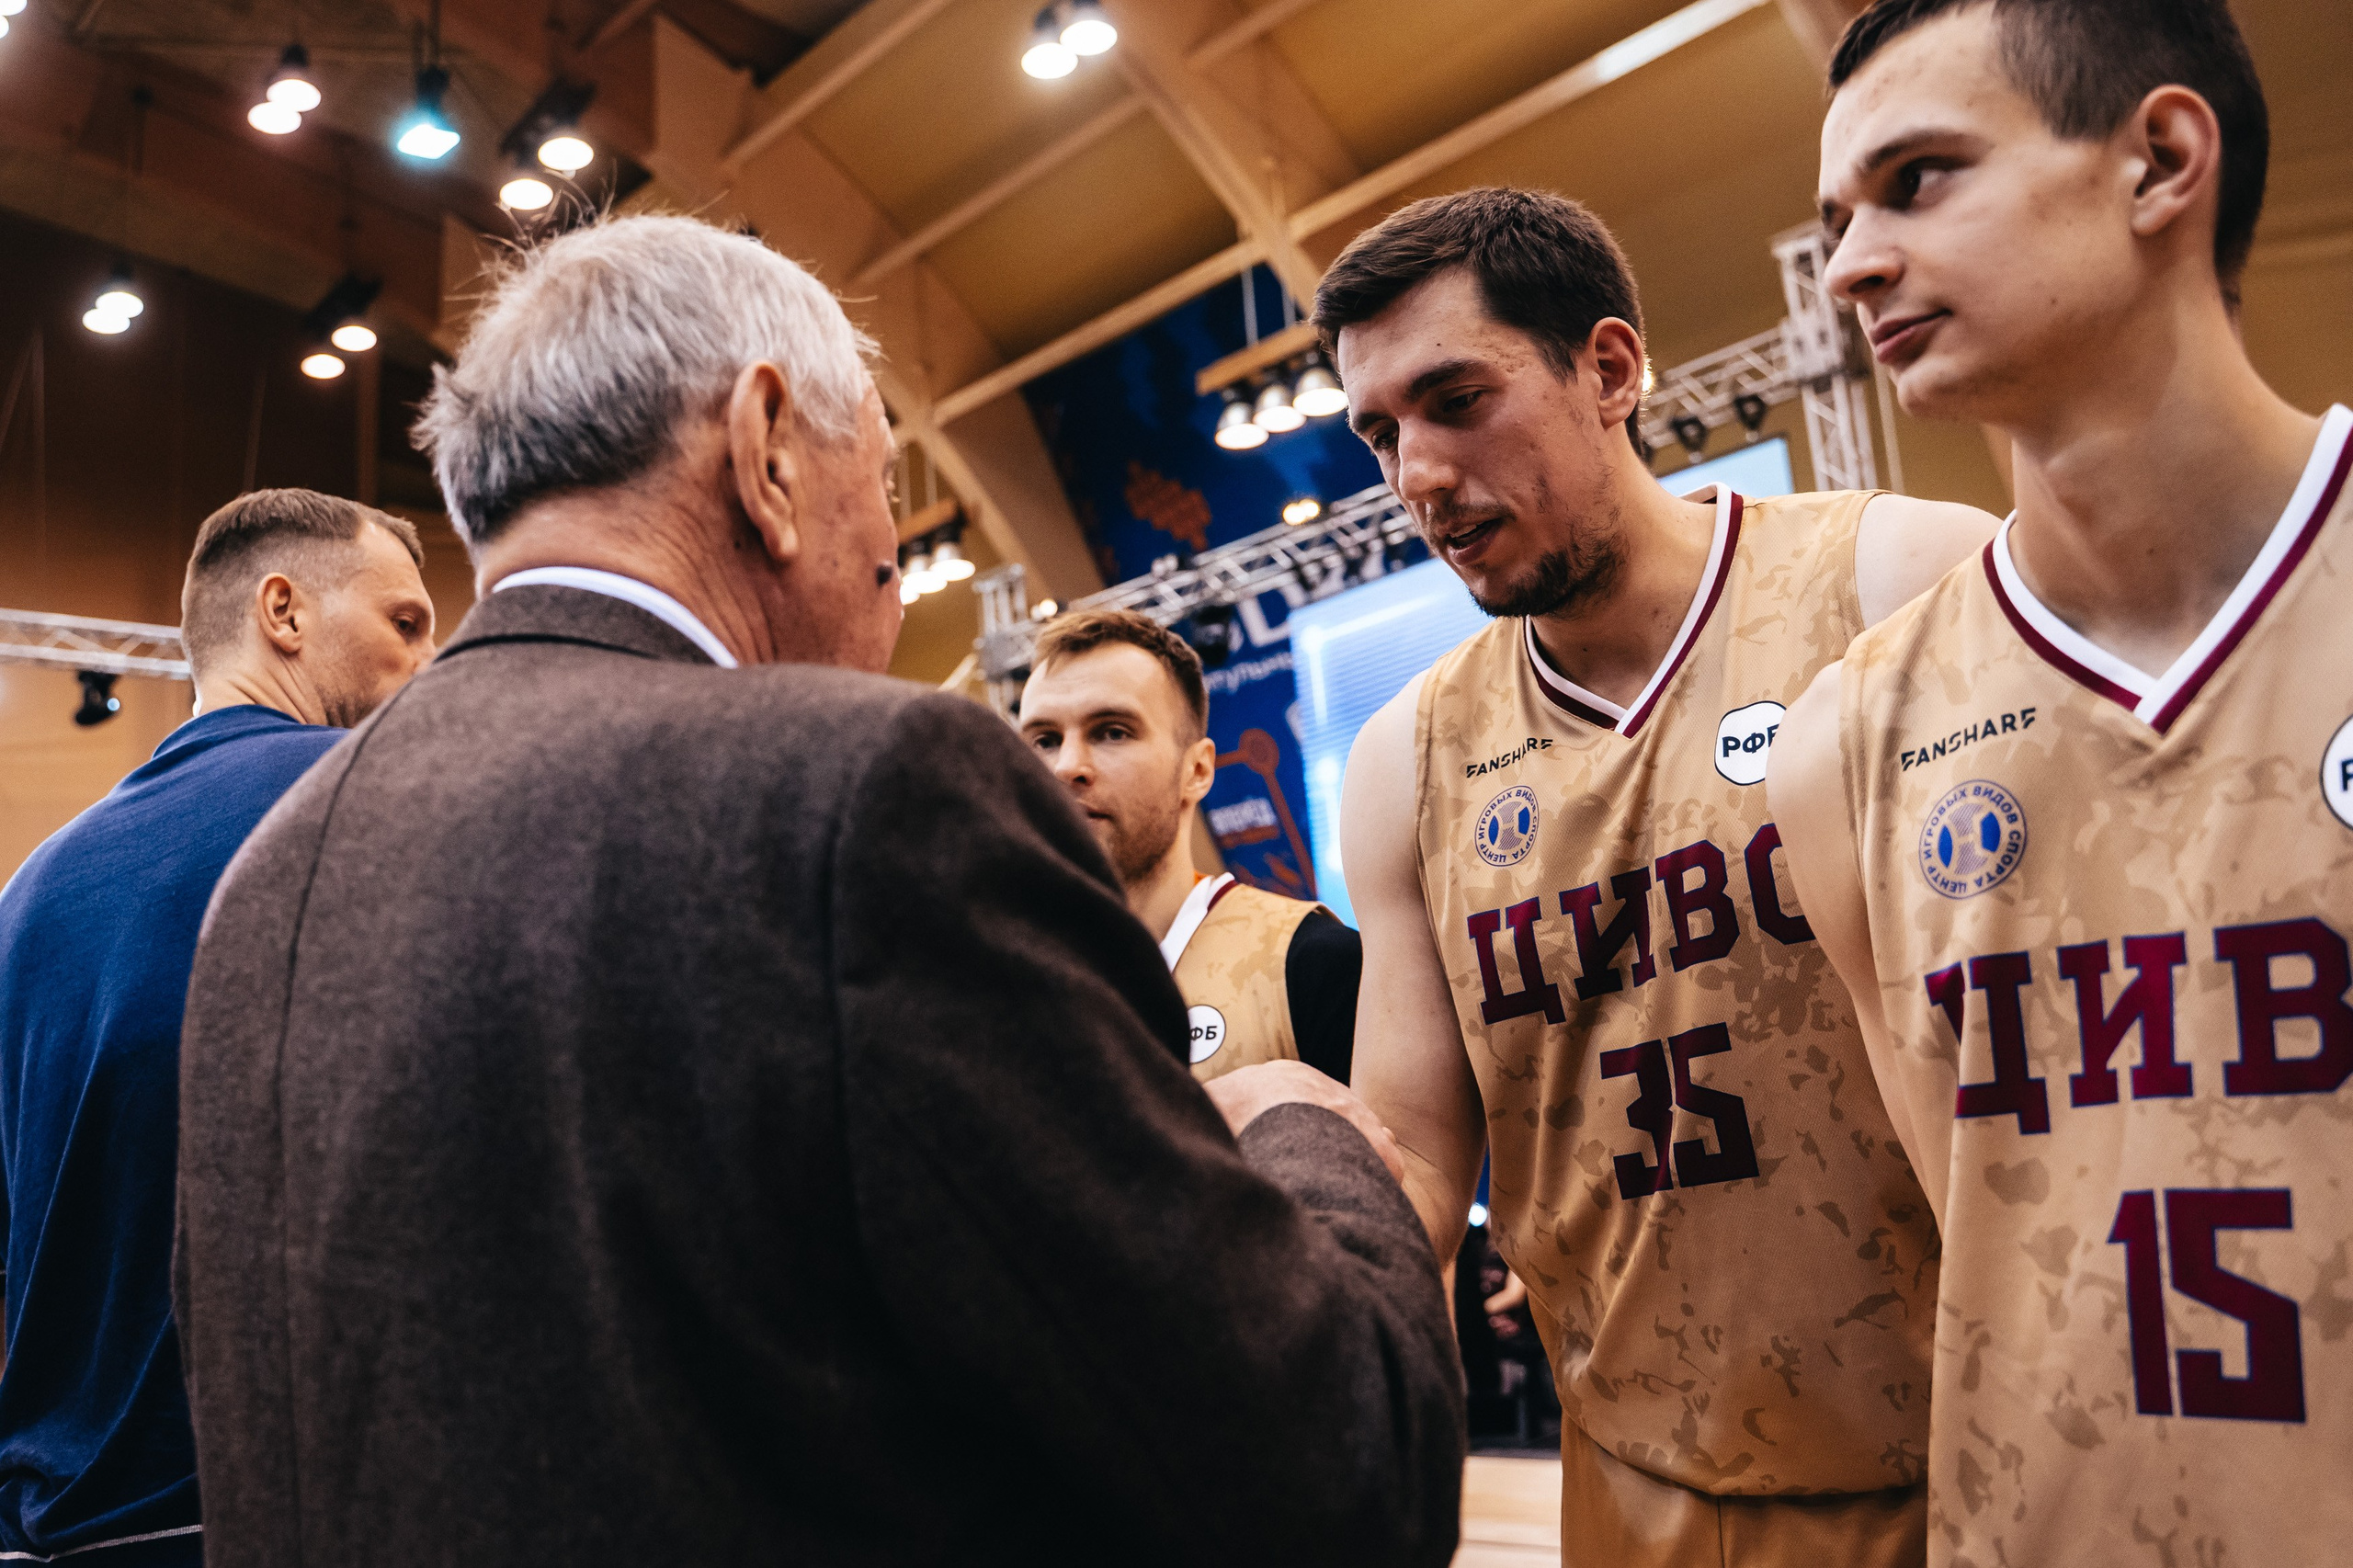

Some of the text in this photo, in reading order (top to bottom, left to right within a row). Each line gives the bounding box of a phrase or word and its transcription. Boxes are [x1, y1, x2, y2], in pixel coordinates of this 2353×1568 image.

[1478, 790, 1538, 863] ЦЕНТР ИГРОВЫХ ВИДОВ СПОРТА
[1923, 785, 2021, 893] ЦЕНТР ИГРОВЫХ ВИДОВ СПОРТА
[1467, 823, 1816, 1025] ЦИВС
[1189, 1026, 1217, 1041] ФБ
[1599, 1022, 1759, 1199] 35
[1925, 916, 2353, 1135] ЦИВ
[2106, 1187, 2306, 1424] 15
